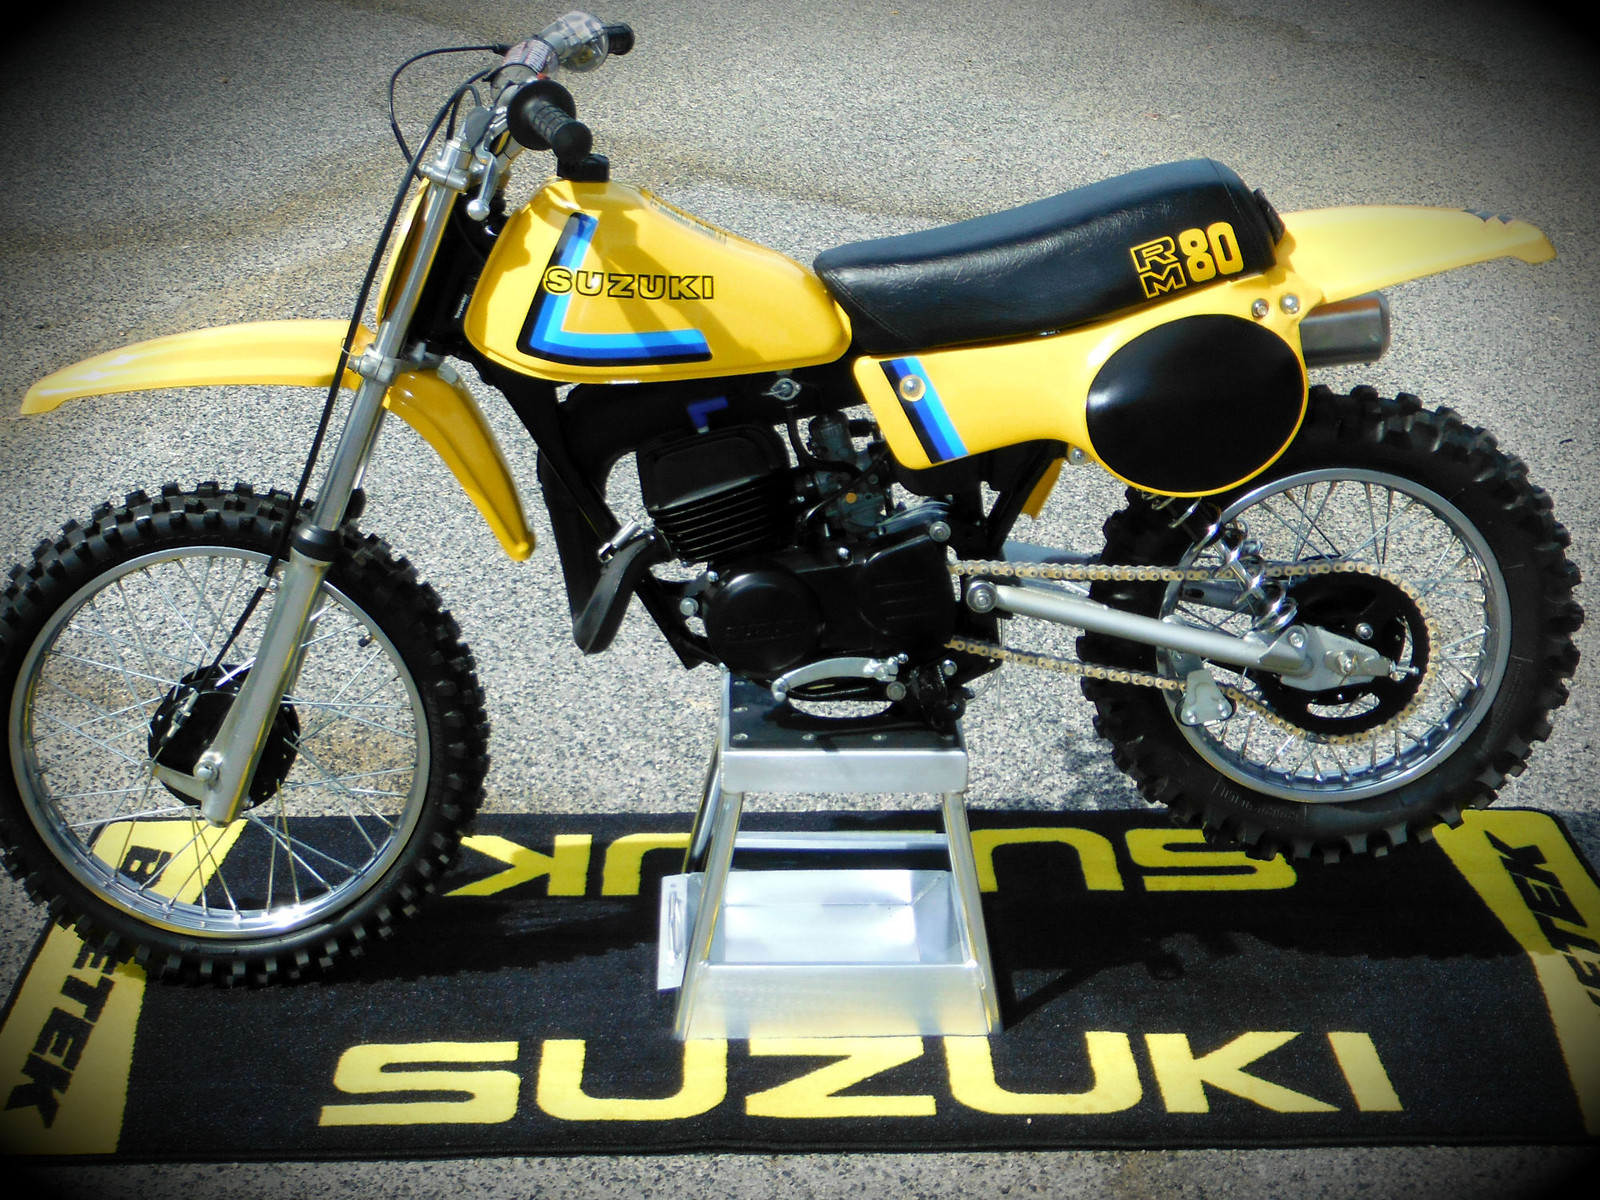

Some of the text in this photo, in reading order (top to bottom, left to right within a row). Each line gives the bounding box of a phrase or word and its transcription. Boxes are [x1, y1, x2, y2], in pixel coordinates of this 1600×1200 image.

[544, 266, 714, 300] SUZUKI
[1178, 221, 1244, 283] 80
[319, 1031, 1403, 1126] SUZUKI
